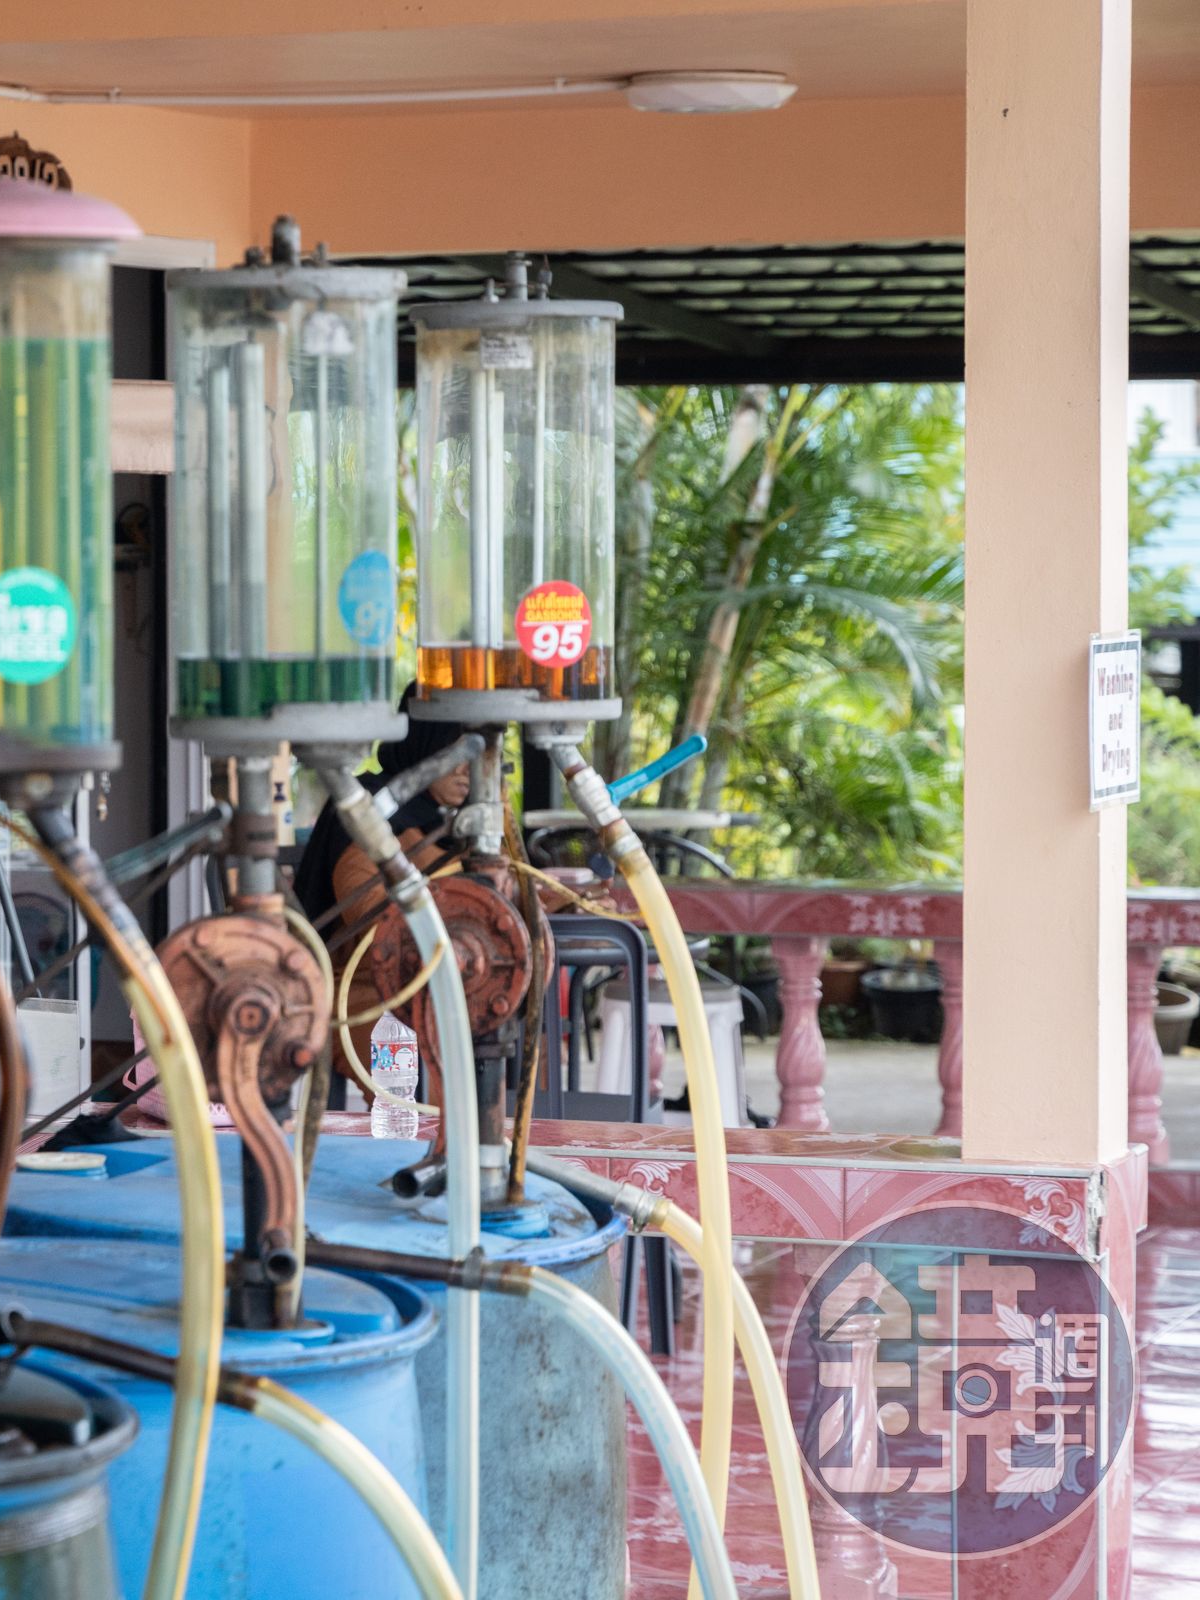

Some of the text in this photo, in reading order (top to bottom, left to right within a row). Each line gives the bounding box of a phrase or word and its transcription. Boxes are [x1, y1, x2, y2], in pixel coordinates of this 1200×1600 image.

[532, 624, 583, 661] 95
[1097, 664, 1134, 700] Washing
[1108, 704, 1123, 731] and
[1102, 740, 1131, 775] Drying
